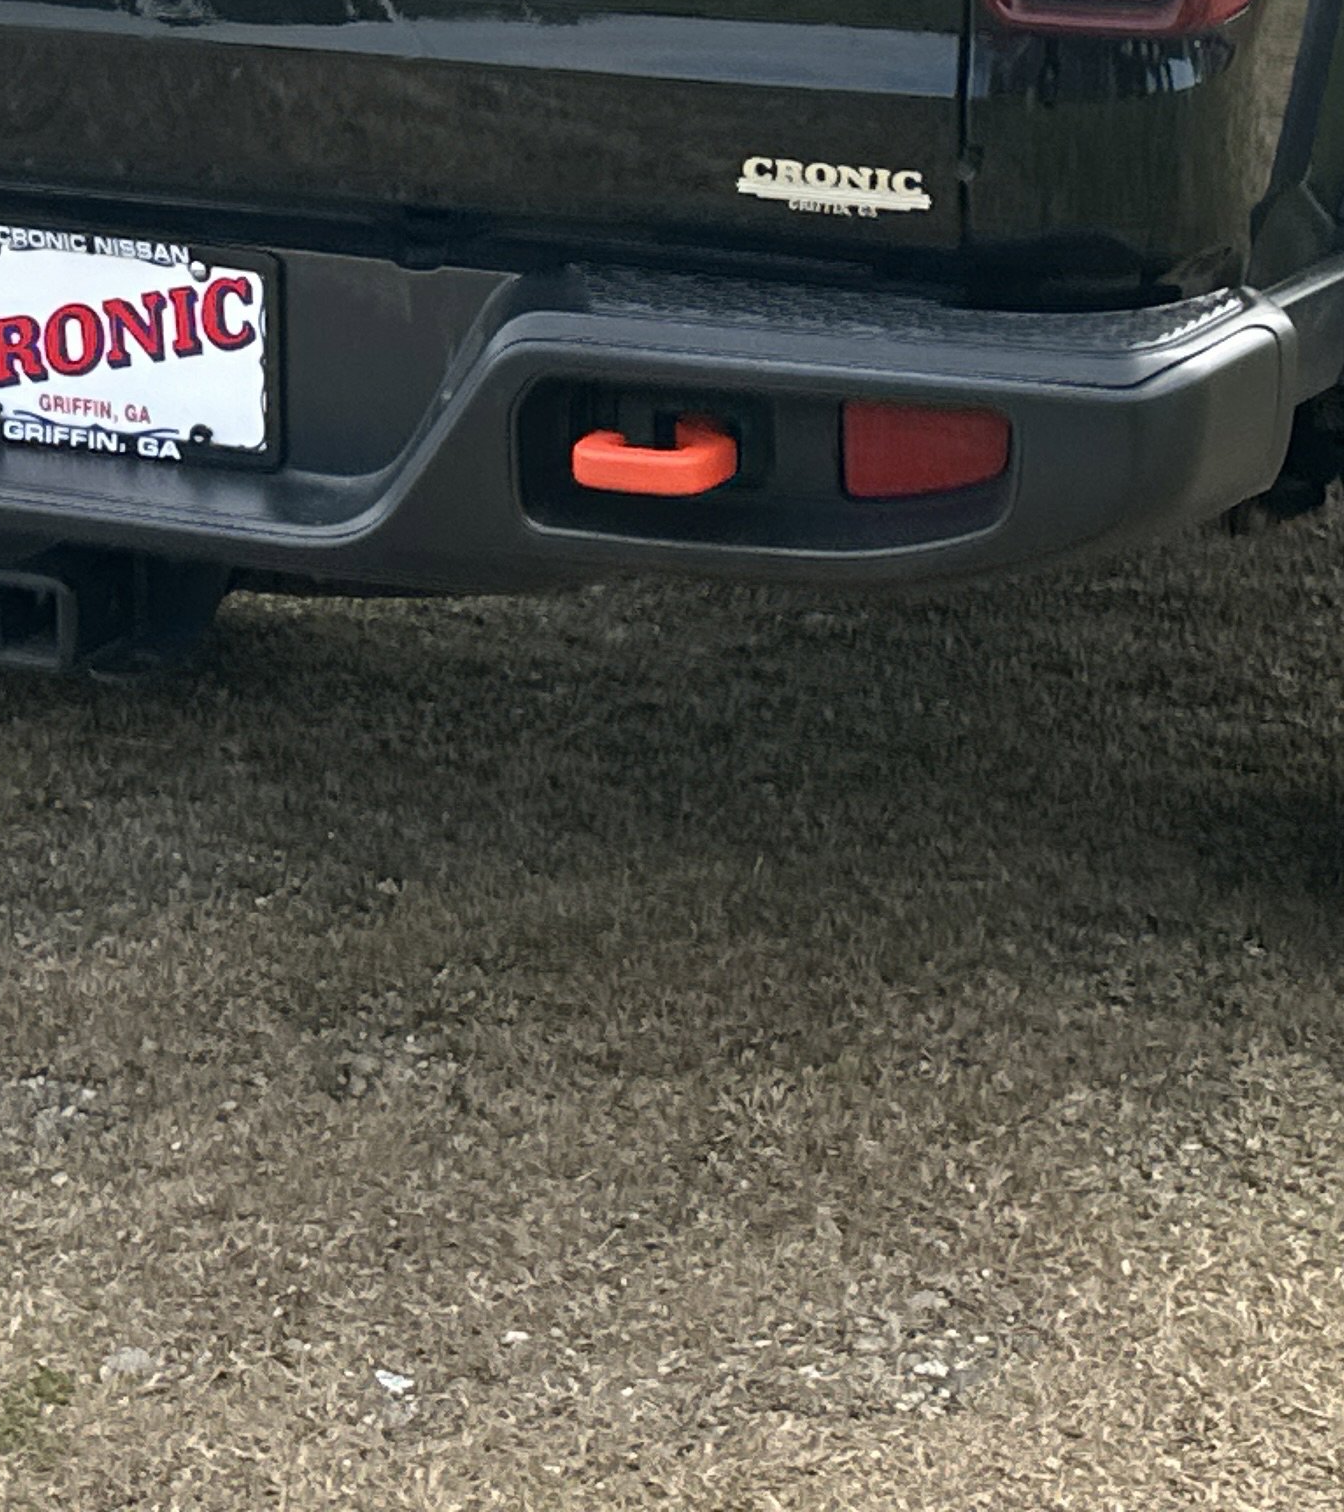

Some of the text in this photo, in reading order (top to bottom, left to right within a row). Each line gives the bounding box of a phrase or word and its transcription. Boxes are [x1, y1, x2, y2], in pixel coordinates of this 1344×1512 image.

[742, 156, 923, 194] CRONIC
[94, 236, 189, 266] NISSAN
[38, 394, 152, 425] GRIFFIN, GA
[137, 437, 181, 460] GA
